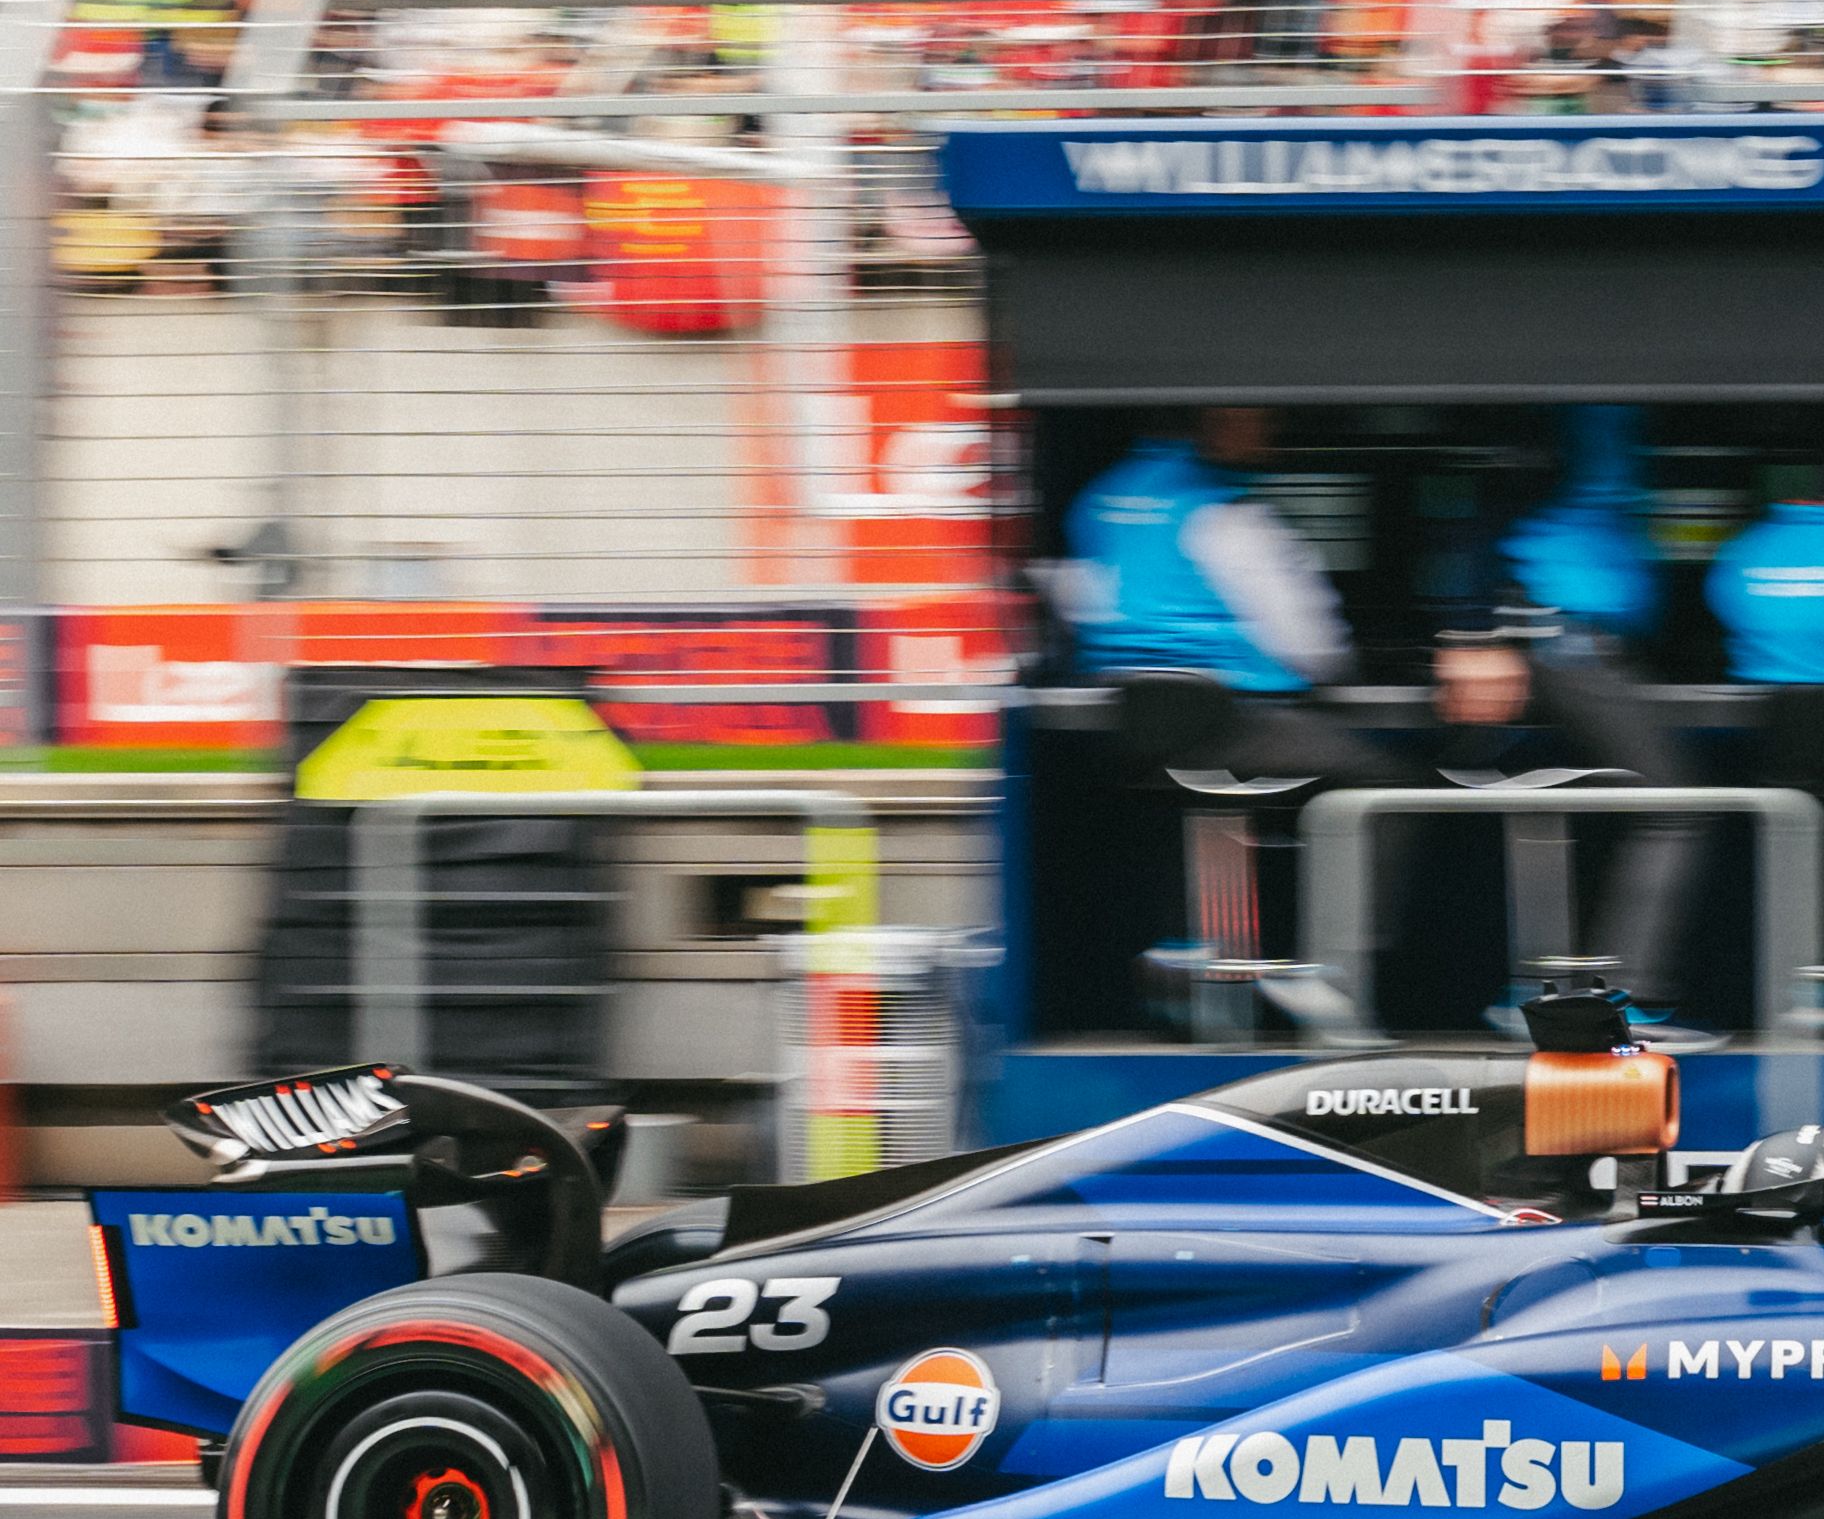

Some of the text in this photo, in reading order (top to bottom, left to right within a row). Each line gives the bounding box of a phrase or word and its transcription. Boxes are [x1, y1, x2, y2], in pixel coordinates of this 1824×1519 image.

[1306, 1088, 1479, 1115] DURACELL
[1660, 1195, 1704, 1207] ALBON
[130, 1207, 396, 1247] KOMATSU
[668, 1276, 842, 1355] 23
[888, 1389, 989, 1426] Gulf
[1164, 1419, 1624, 1510] KOMATSU
